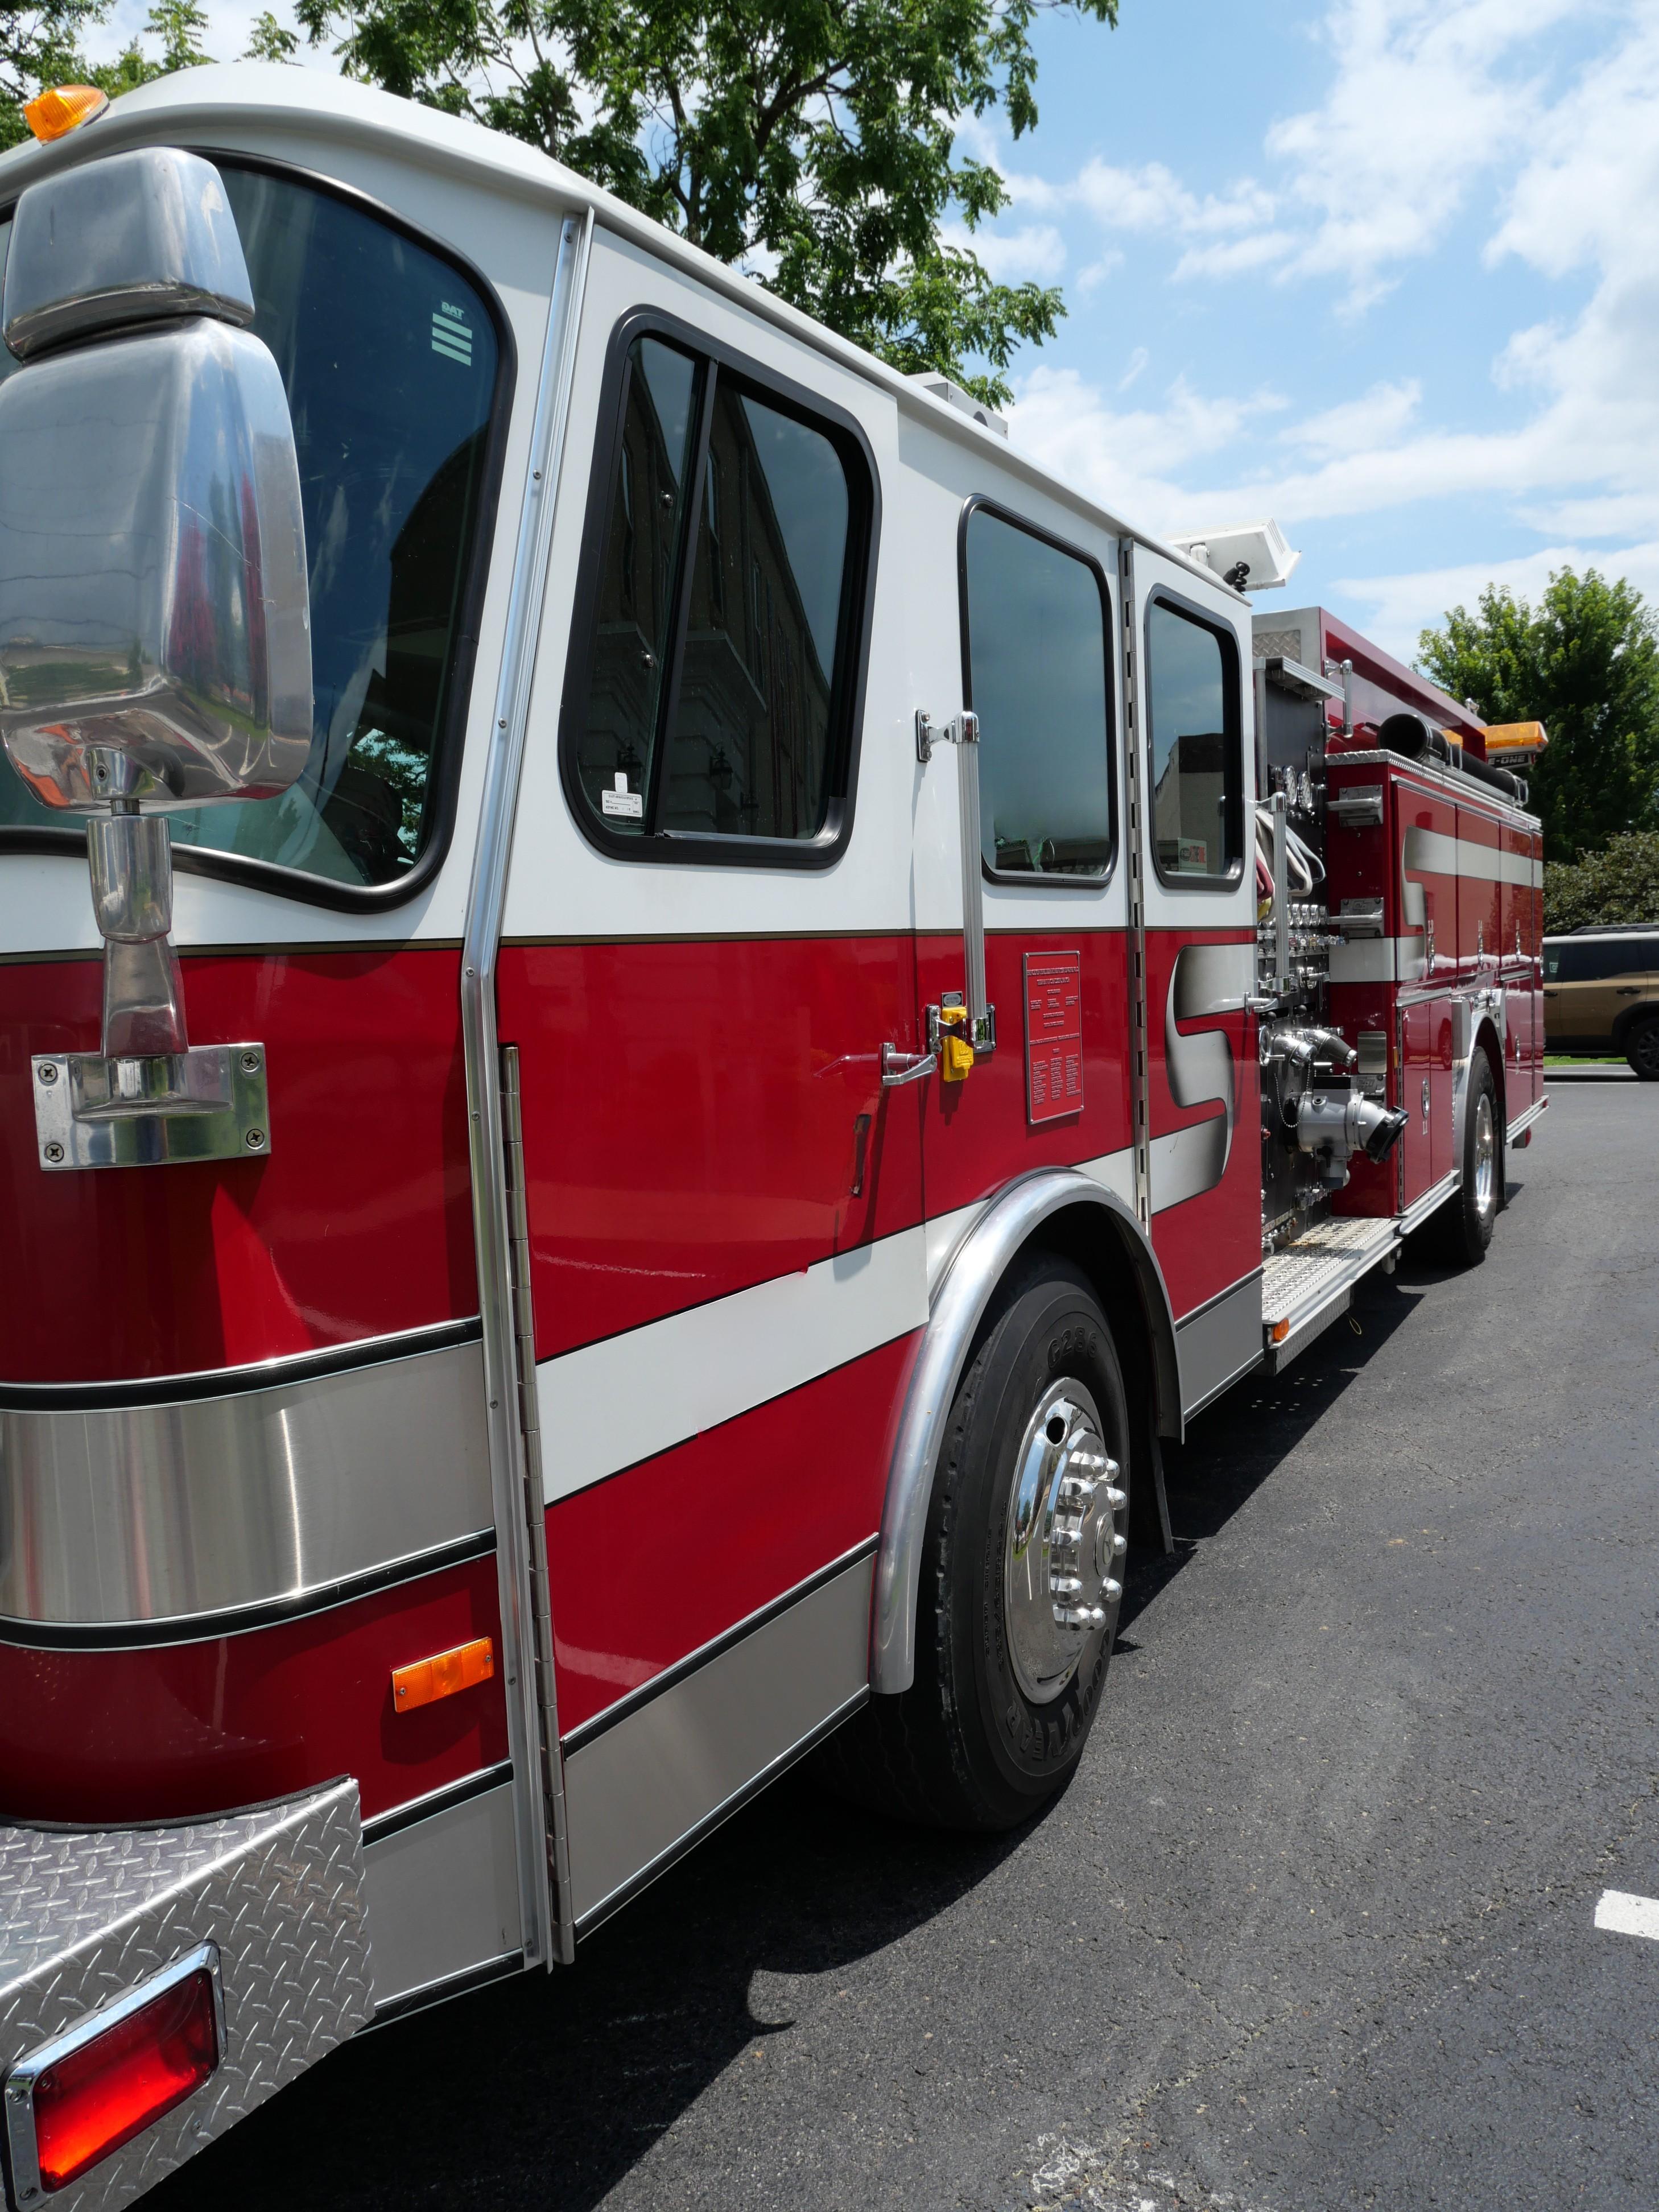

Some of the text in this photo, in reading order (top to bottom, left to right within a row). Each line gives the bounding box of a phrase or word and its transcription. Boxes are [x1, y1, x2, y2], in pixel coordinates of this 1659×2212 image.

[1488, 755, 1525, 765] E-ONE
[1422, 1120, 1427, 1135] L1
[1047, 1326, 1097, 1368] G286
[1006, 1629, 1110, 1761] GOODYEAR
